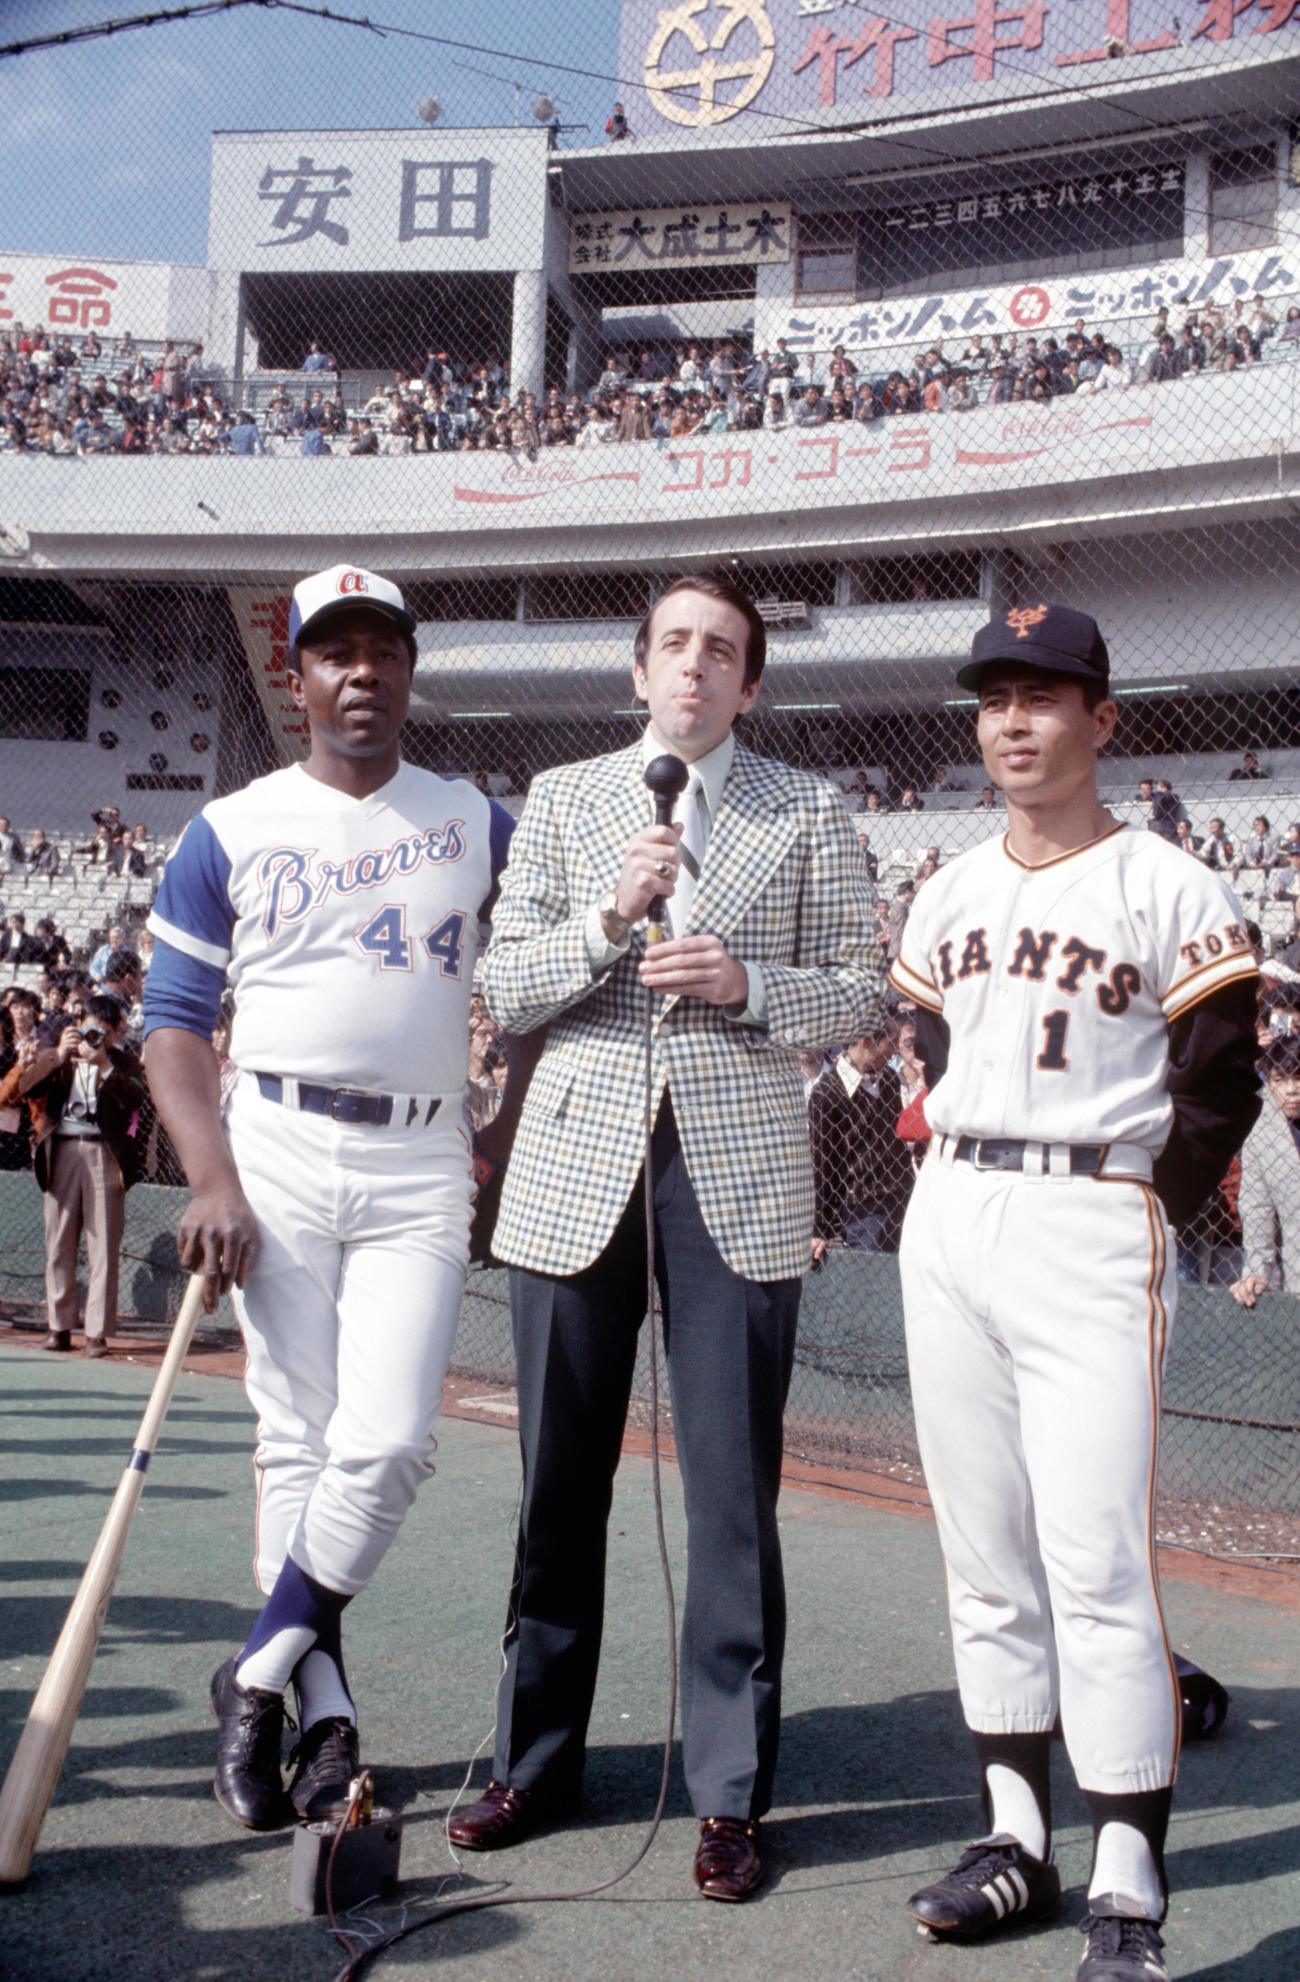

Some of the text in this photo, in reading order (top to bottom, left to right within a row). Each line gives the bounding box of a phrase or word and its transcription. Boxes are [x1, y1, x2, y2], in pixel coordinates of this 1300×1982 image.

[256, 157, 496, 248] 安田
[615, 209, 788, 262] 大成土木
[0, 268, 118, 329] 命
[1065, 255, 1295, 318] ニッポンハム
[786, 298, 998, 345] ニッポンハム
[662, 427, 931, 492] コカ・コーラ
[257, 818, 466, 946] Braves
[353, 903, 468, 981] 44
[936, 926, 1142, 1016] IANTS
[1179, 922, 1247, 968] TOK
[1037, 1009, 1070, 1071] 1
